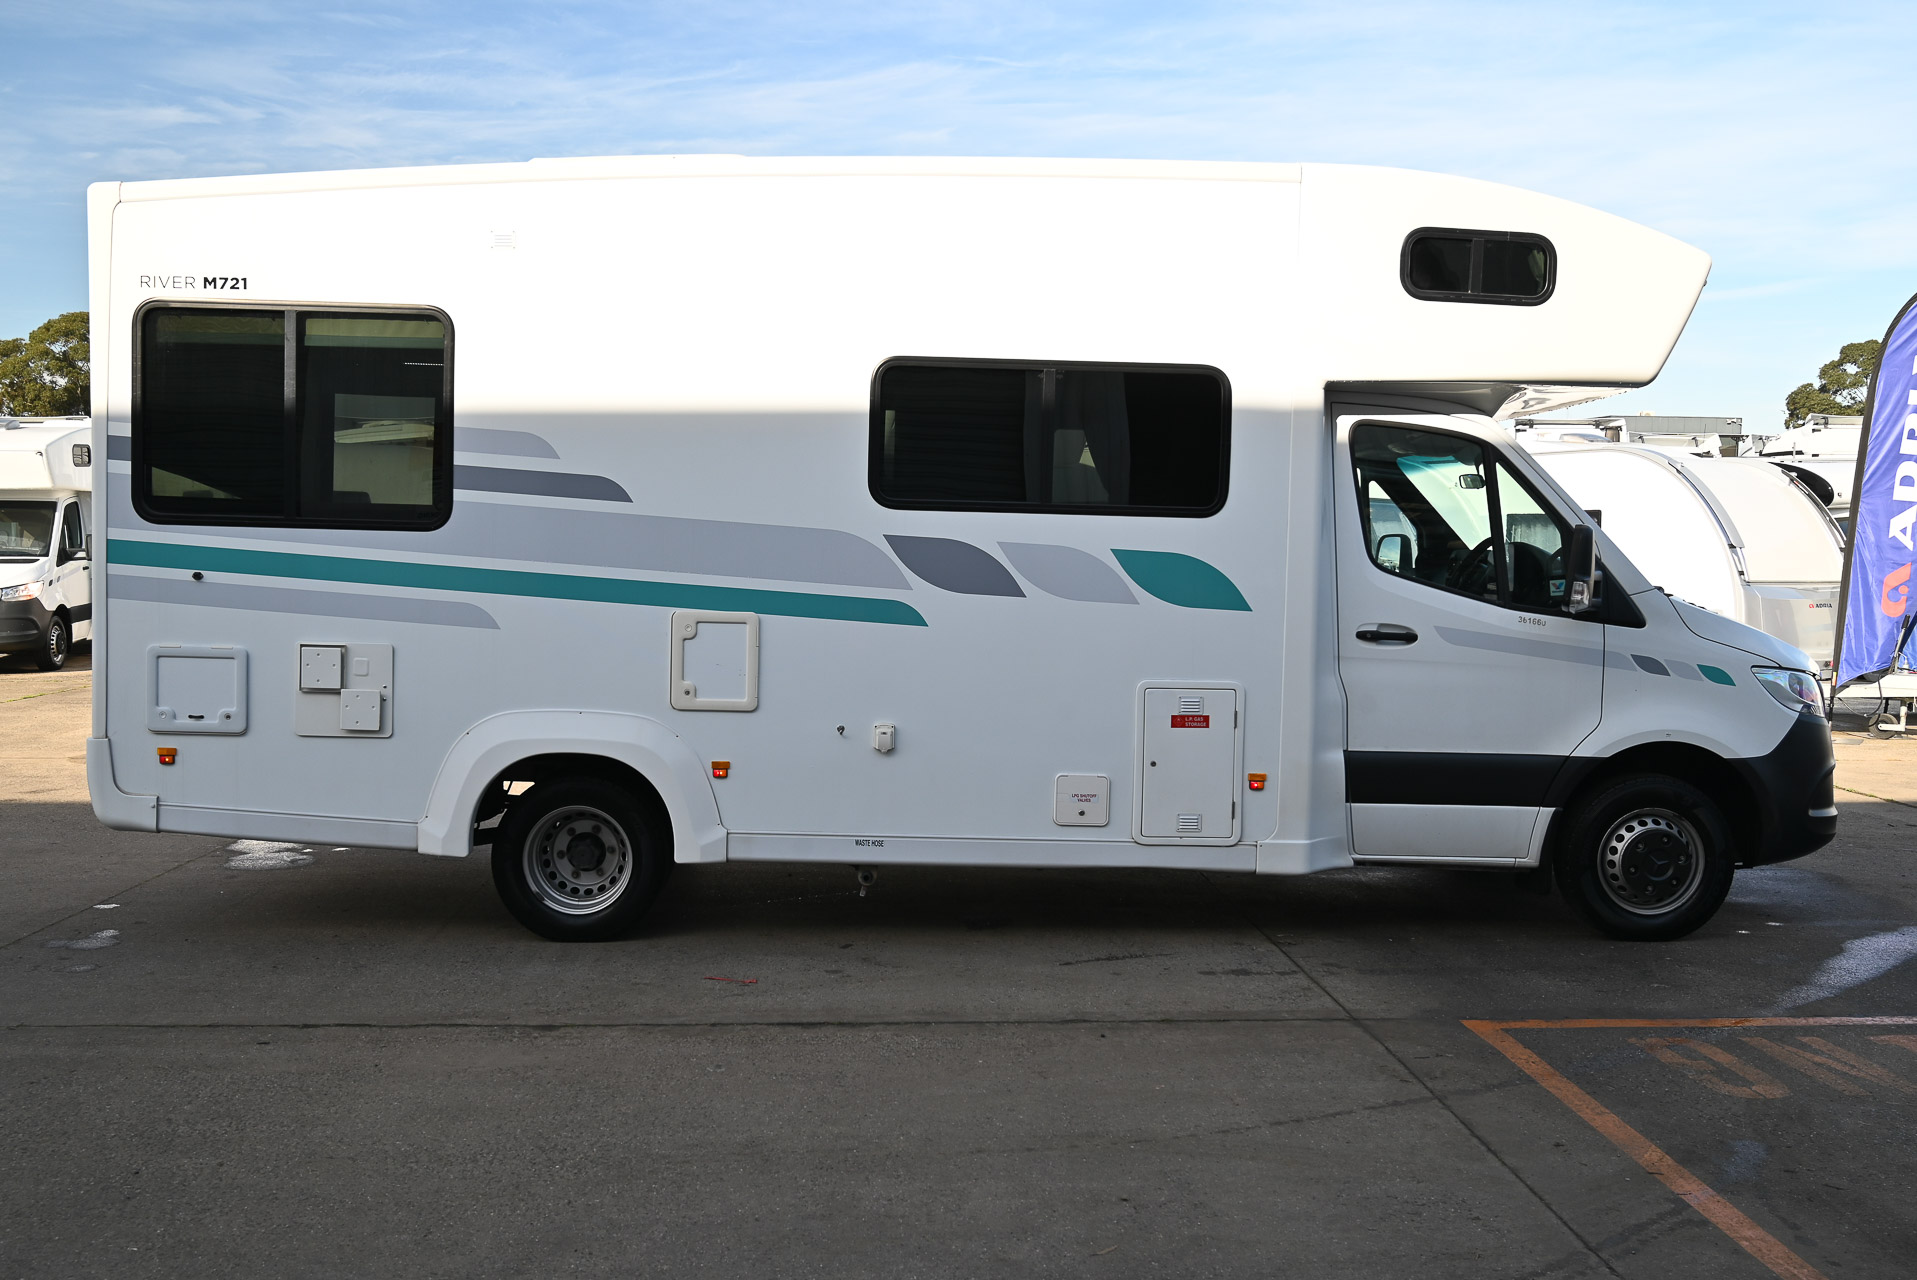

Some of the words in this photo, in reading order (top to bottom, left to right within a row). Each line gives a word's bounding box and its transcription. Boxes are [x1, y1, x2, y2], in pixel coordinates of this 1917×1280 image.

[140, 275, 196, 289] RIVER
[203, 276, 248, 290] M721
[1888, 355, 1917, 552] ADR
[855, 839, 871, 847] WASTE
[871, 839, 884, 847] HOSE
